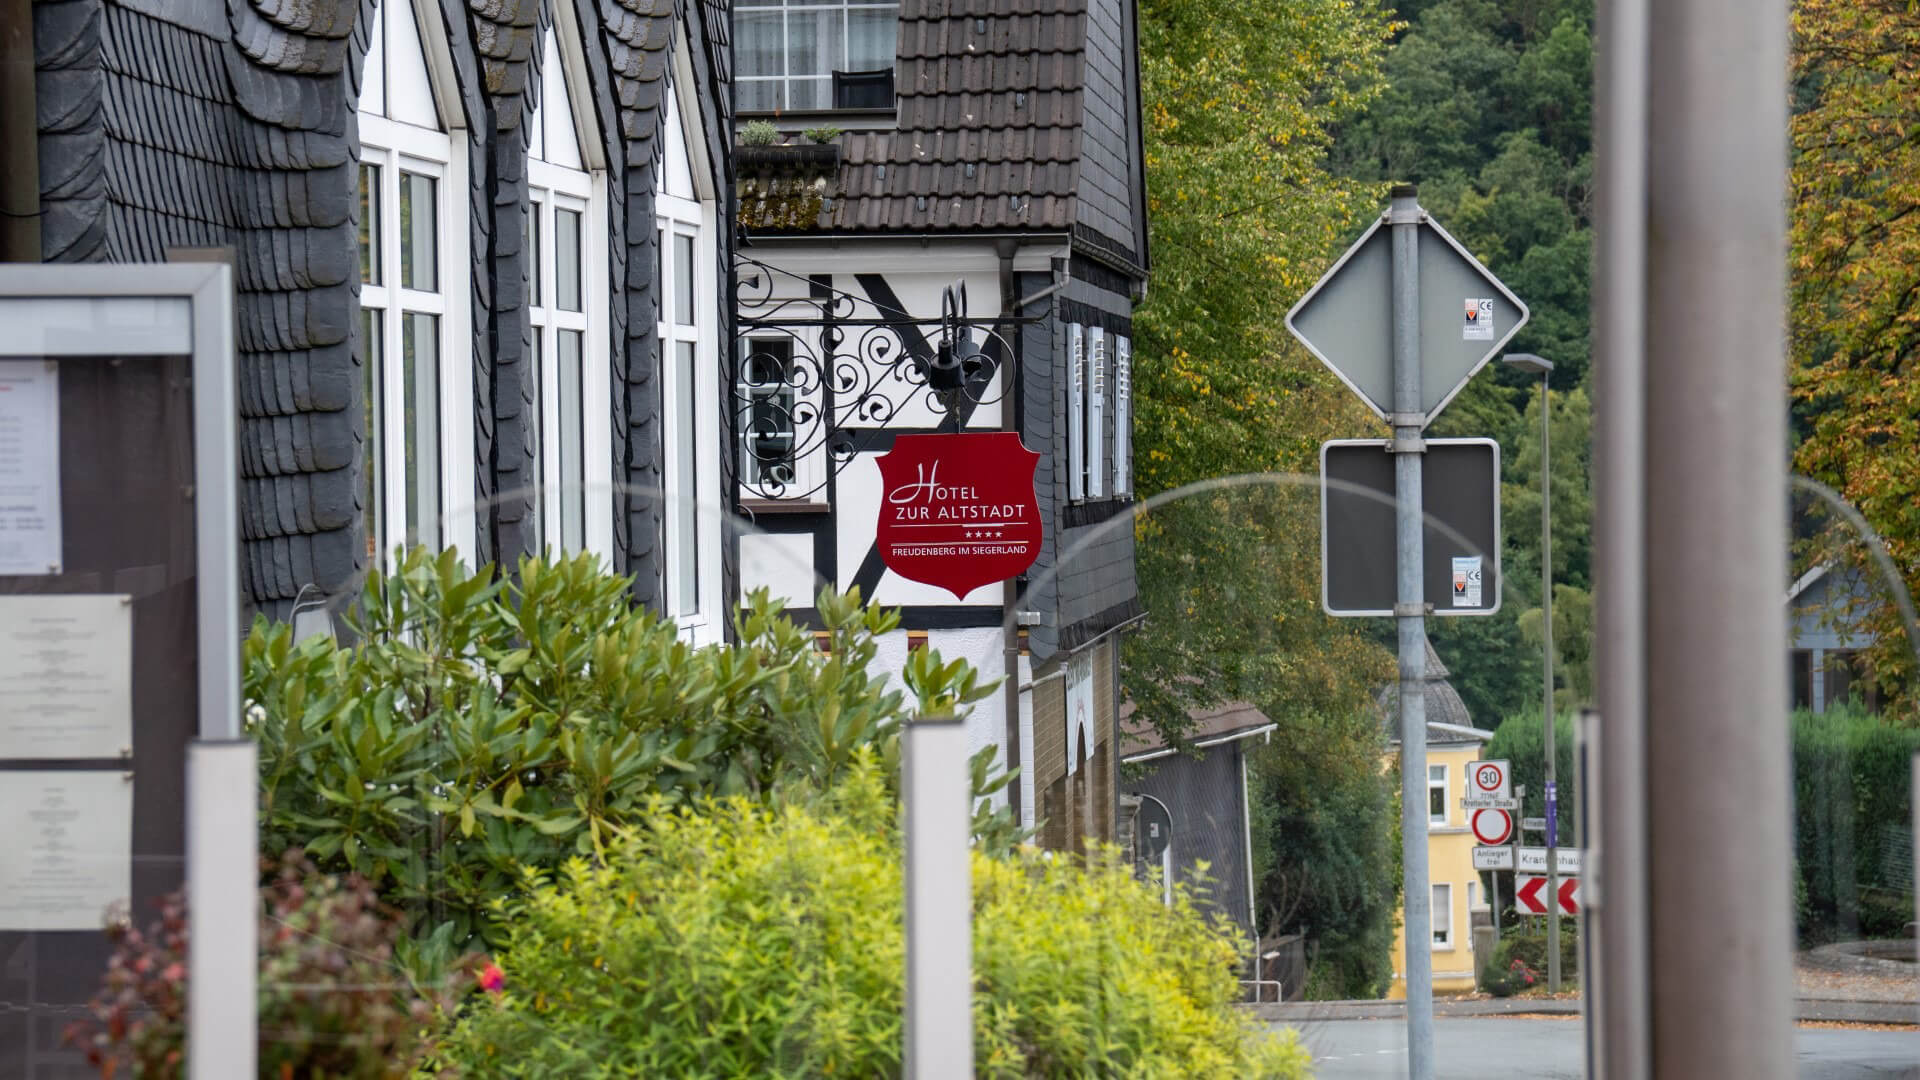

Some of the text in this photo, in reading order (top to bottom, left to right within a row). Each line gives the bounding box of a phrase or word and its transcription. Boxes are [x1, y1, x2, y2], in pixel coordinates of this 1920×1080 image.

[889, 459, 979, 504] HOTEL
[896, 504, 1025, 520] ZUR ALTSTADT
[892, 545, 1027, 556] FREUDENBERG IM SIEGERLAND
[1481, 771, 1497, 784] 30
[1477, 850, 1509, 859] Anlieger
